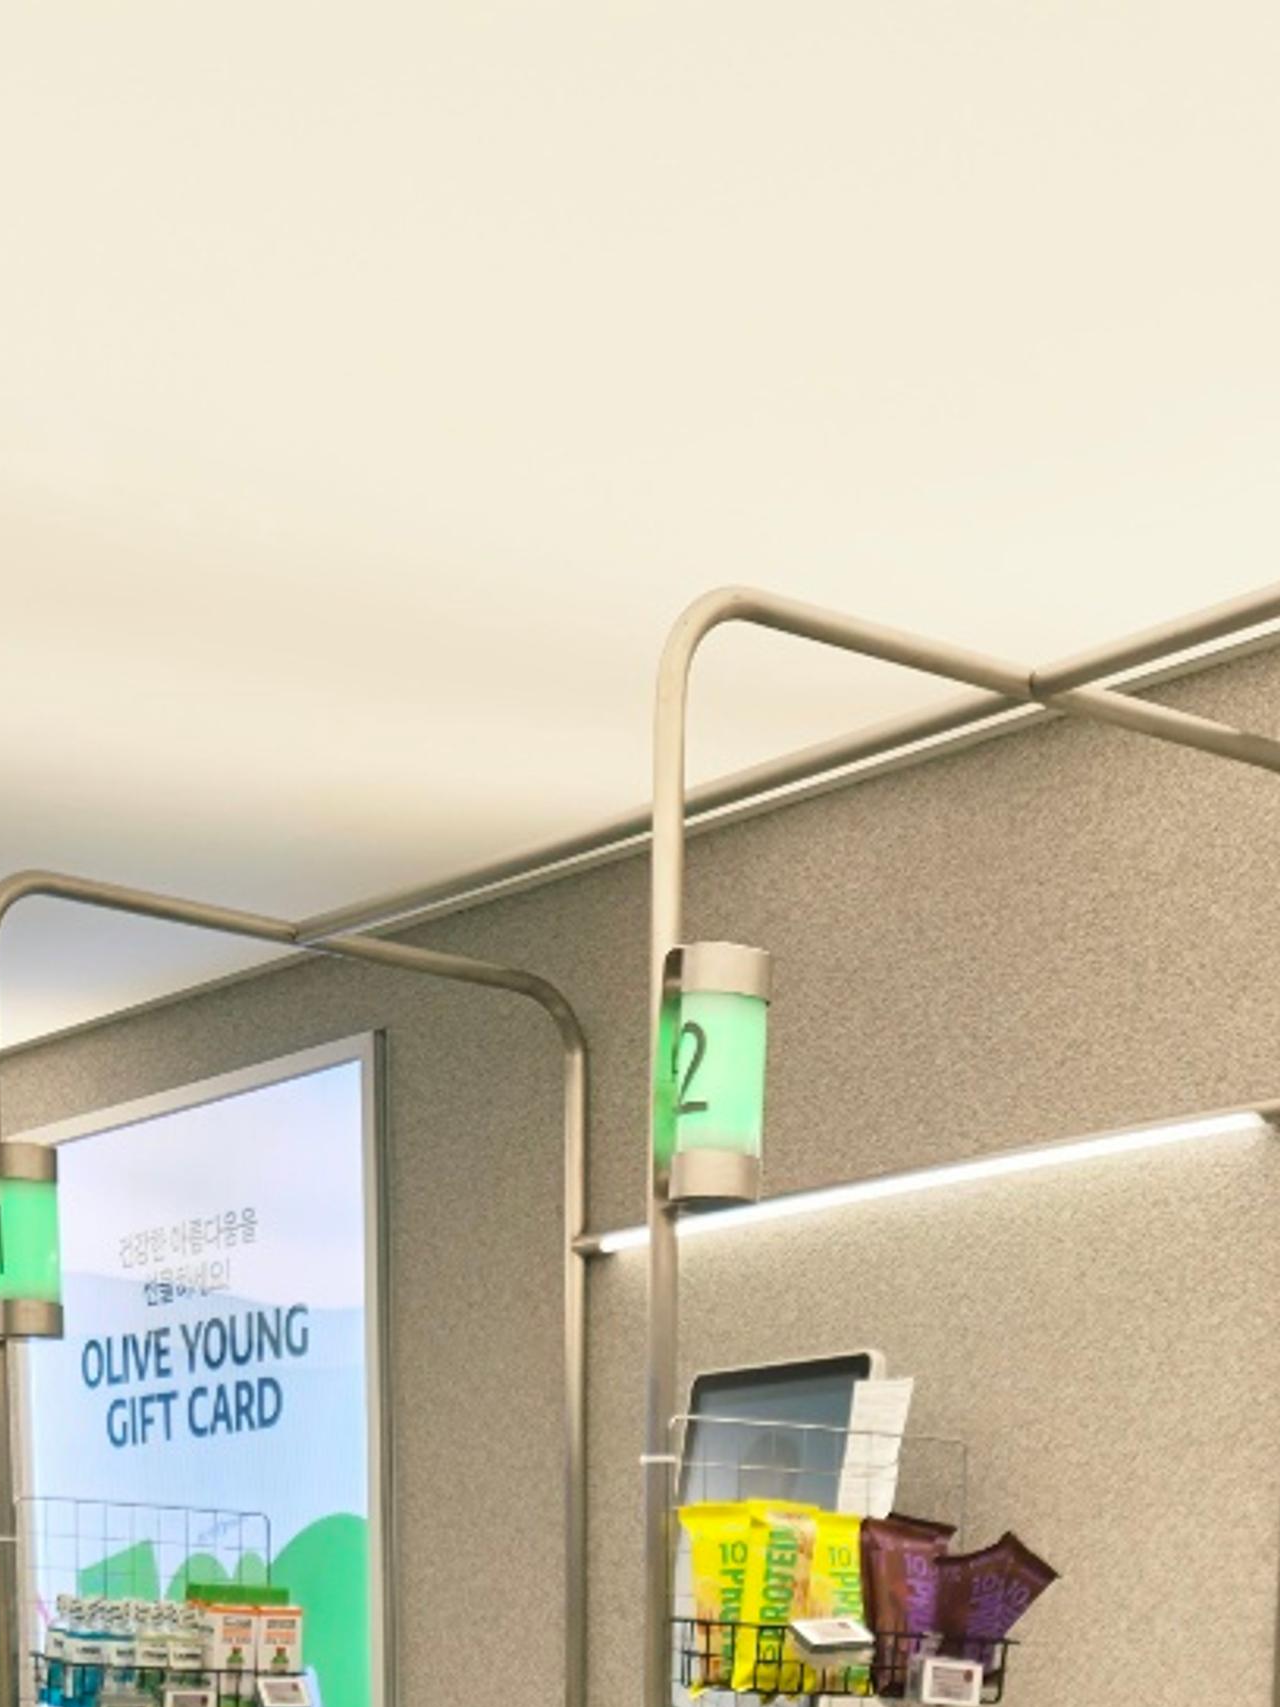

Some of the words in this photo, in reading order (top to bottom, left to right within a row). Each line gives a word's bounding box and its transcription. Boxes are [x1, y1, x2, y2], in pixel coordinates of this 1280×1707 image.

[672, 1021, 707, 1116] 2
[81, 1327, 173, 1390] OLIVE
[180, 1303, 310, 1375] YOUNG
[106, 1390, 179, 1449] GIFT
[187, 1376, 283, 1438] CARD
